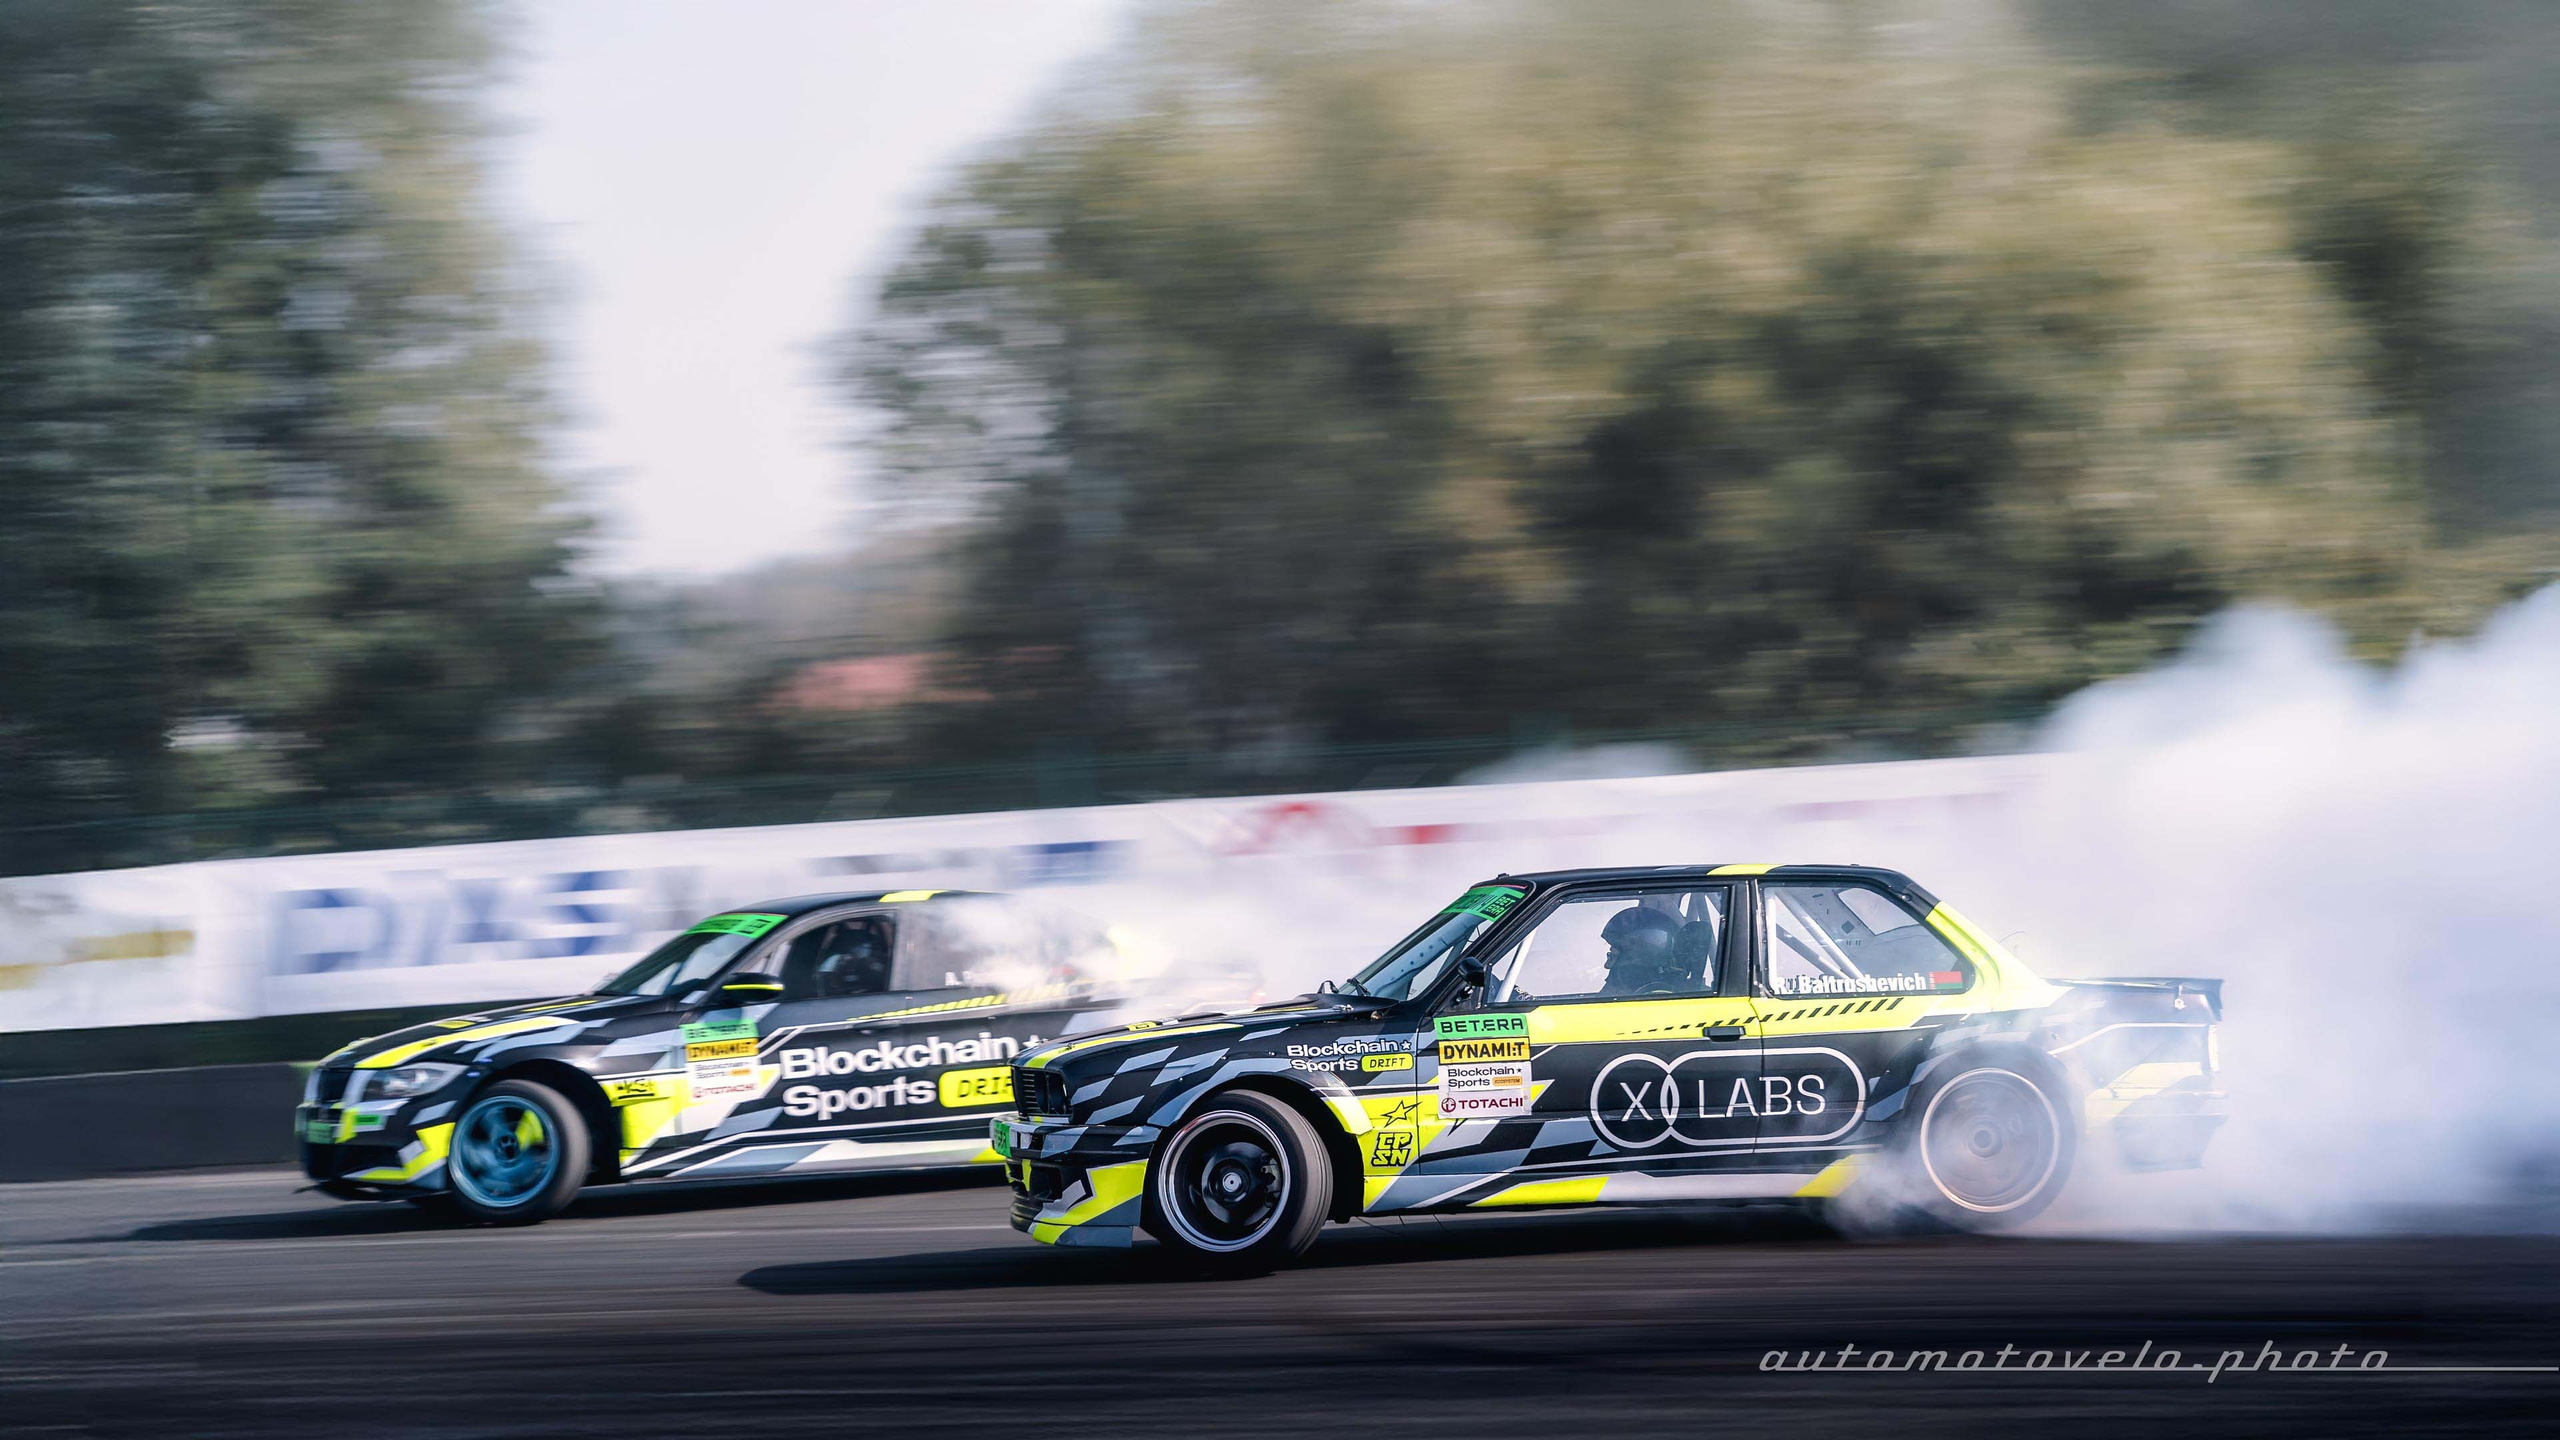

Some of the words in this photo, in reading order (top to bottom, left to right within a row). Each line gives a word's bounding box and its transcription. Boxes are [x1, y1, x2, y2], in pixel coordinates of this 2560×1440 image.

[779, 1032, 1019, 1080] Blockchain
[1286, 1038, 1399, 1057] Blockchain
[1290, 1057, 1359, 1073] Sports
[1369, 1057, 1406, 1069] DRIFT
[1447, 1066, 1515, 1078] Blockchain
[1448, 1078, 1491, 1089] Sports
[782, 1076, 937, 1121] Sports
[957, 1075, 1013, 1098] DRIF
[1458, 1097, 1524, 1110] TOTACHI
[1619, 1080, 1654, 1122] X
[1698, 1074, 1826, 1119] LABS
